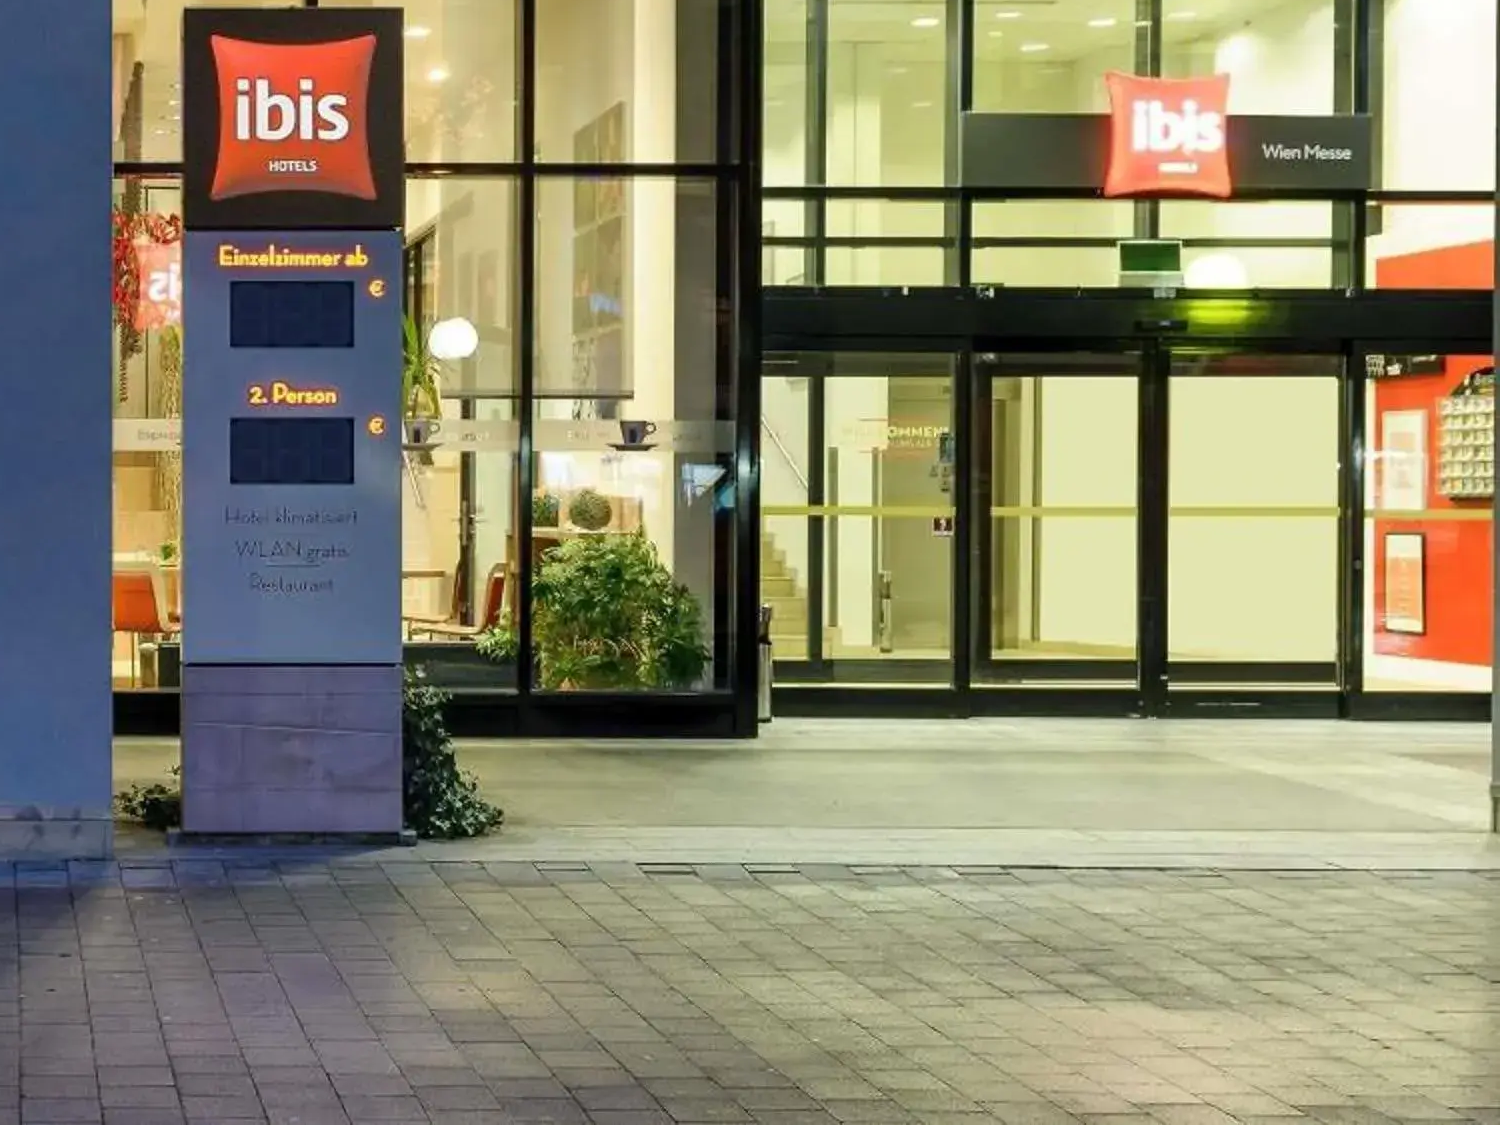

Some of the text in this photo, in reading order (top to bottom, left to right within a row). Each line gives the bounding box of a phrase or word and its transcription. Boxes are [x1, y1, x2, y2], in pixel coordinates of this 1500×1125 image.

[235, 78, 350, 141] ibis
[1131, 99, 1223, 152] ibis
[1262, 143, 1352, 160] Wien Messe
[268, 160, 318, 172] HOTELS
[218, 244, 369, 267] Einzelzimmer ab
[249, 382, 338, 404] 2. Person
[224, 506, 269, 525] Hotel
[234, 541, 302, 559] WLAN
[249, 573, 334, 593] Restaurant
